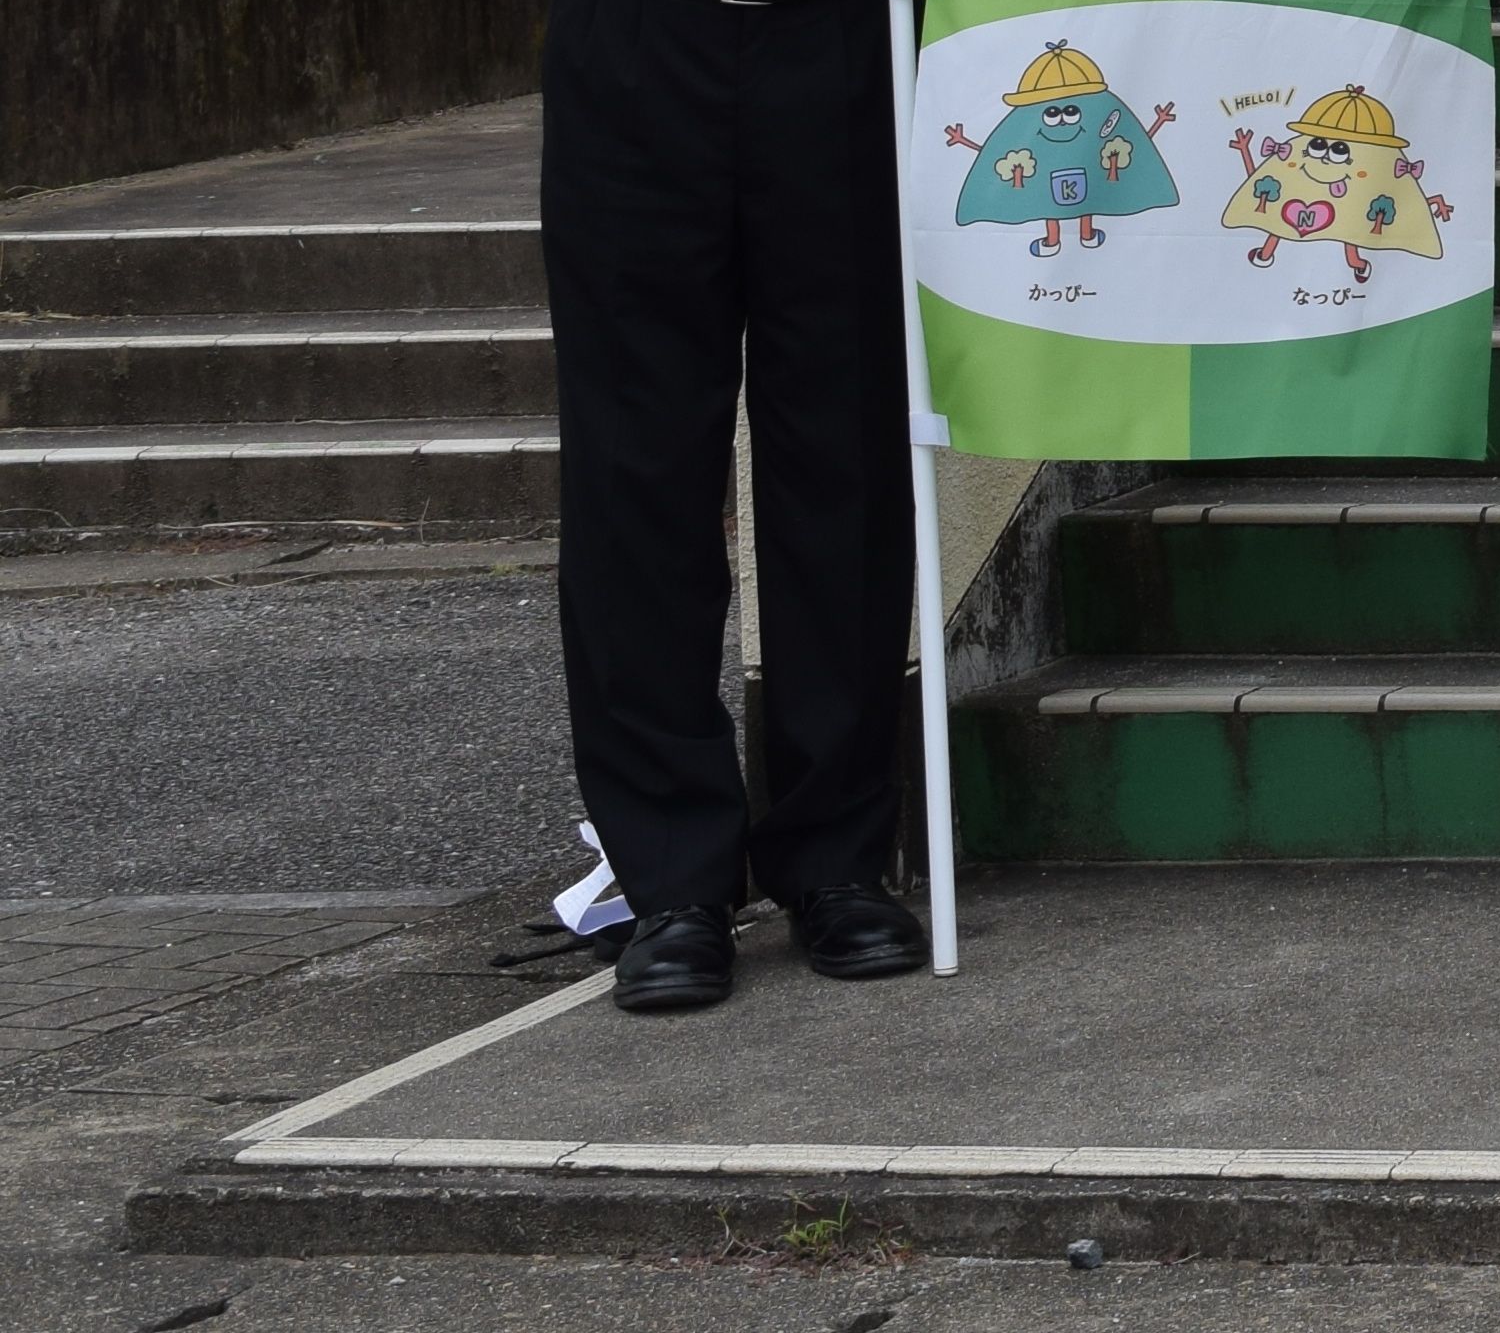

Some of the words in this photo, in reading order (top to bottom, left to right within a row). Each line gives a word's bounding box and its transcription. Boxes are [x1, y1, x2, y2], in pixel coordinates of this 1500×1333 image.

[1060, 178, 1077, 201] K
[1298, 209, 1316, 229] N
[1028, 283, 1098, 303] かっぴー
[1291, 285, 1367, 306] なっぴー
